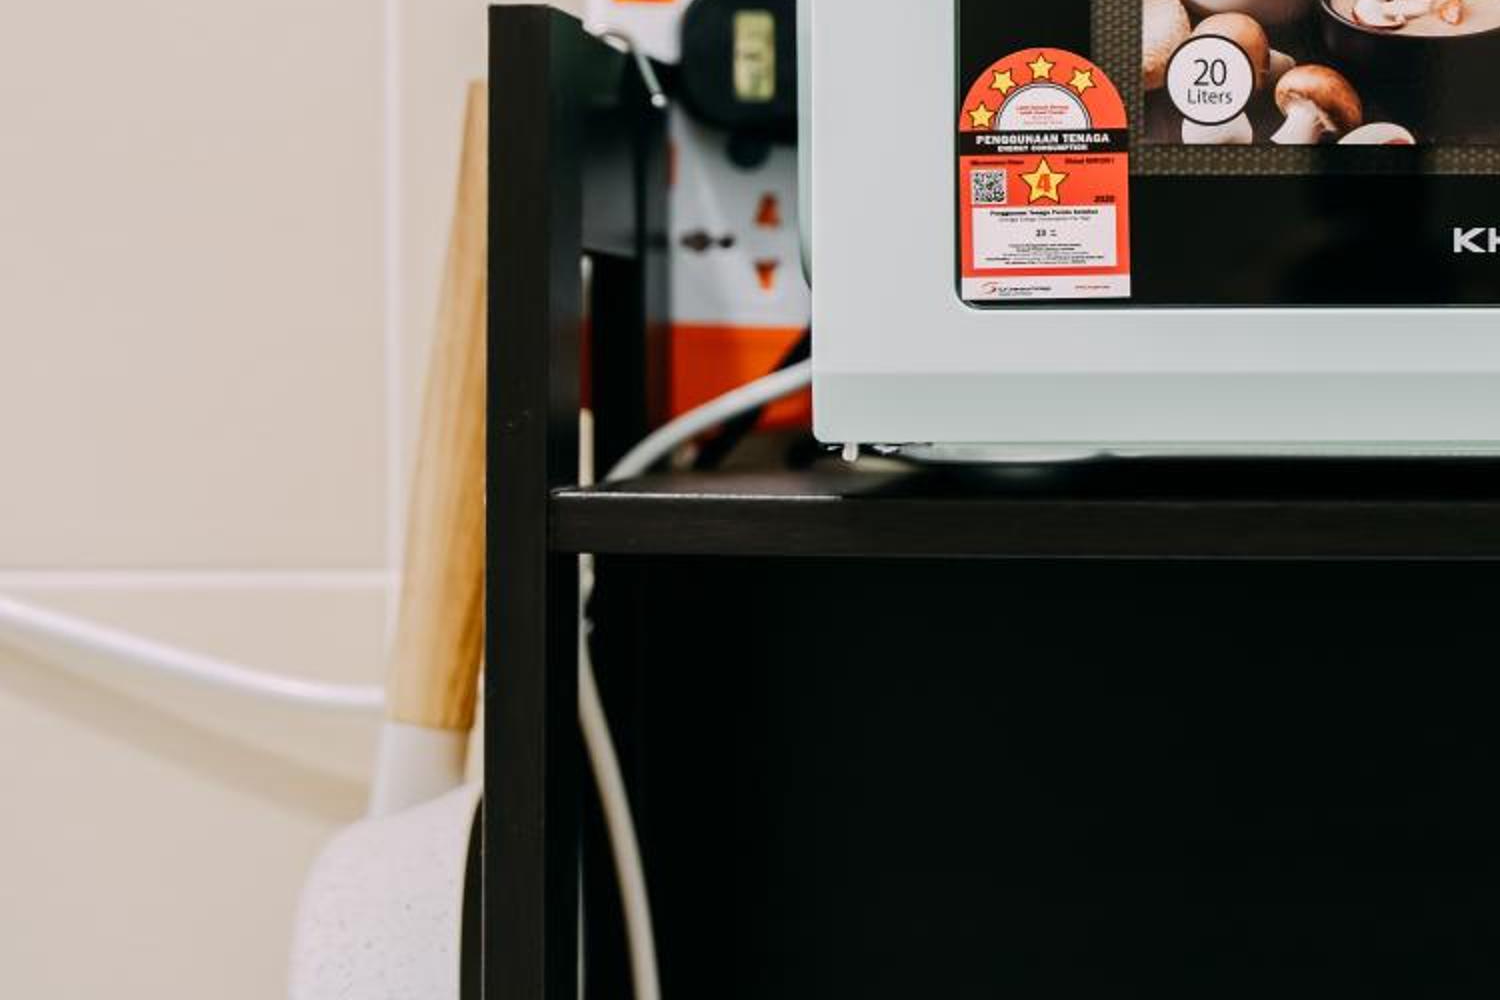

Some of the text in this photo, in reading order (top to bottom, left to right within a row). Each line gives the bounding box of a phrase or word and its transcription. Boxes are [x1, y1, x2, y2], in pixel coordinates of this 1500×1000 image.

[1192, 57, 1228, 87] 20
[1186, 87, 1234, 105] Liters
[975, 133, 1110, 145] PENGGUNAAN TENAGA
[1037, 174, 1052, 193] 4
